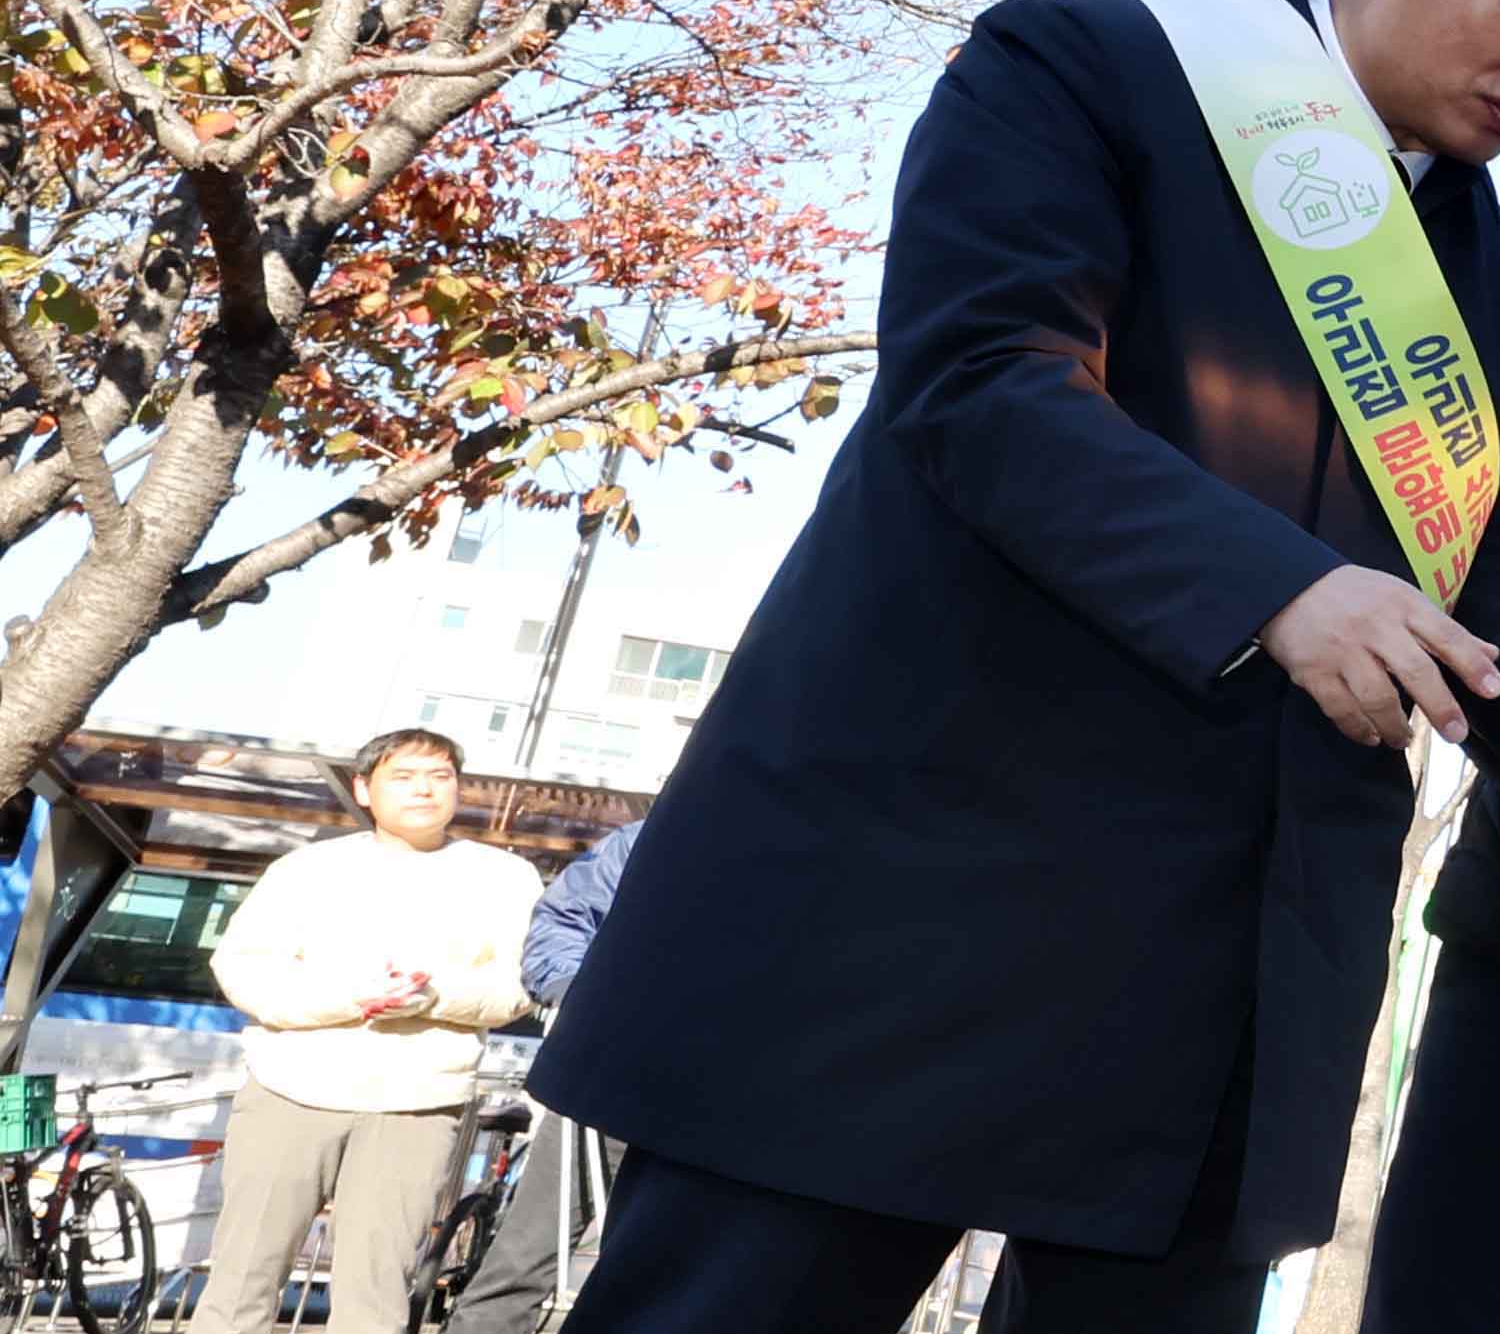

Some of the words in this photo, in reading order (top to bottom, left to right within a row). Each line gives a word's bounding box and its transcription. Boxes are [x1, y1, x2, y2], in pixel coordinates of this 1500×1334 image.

[1305, 274, 1409, 421] 우리집
[1373, 419, 1463, 555] 문앞에
[1404, 334, 1488, 469] 우리집
